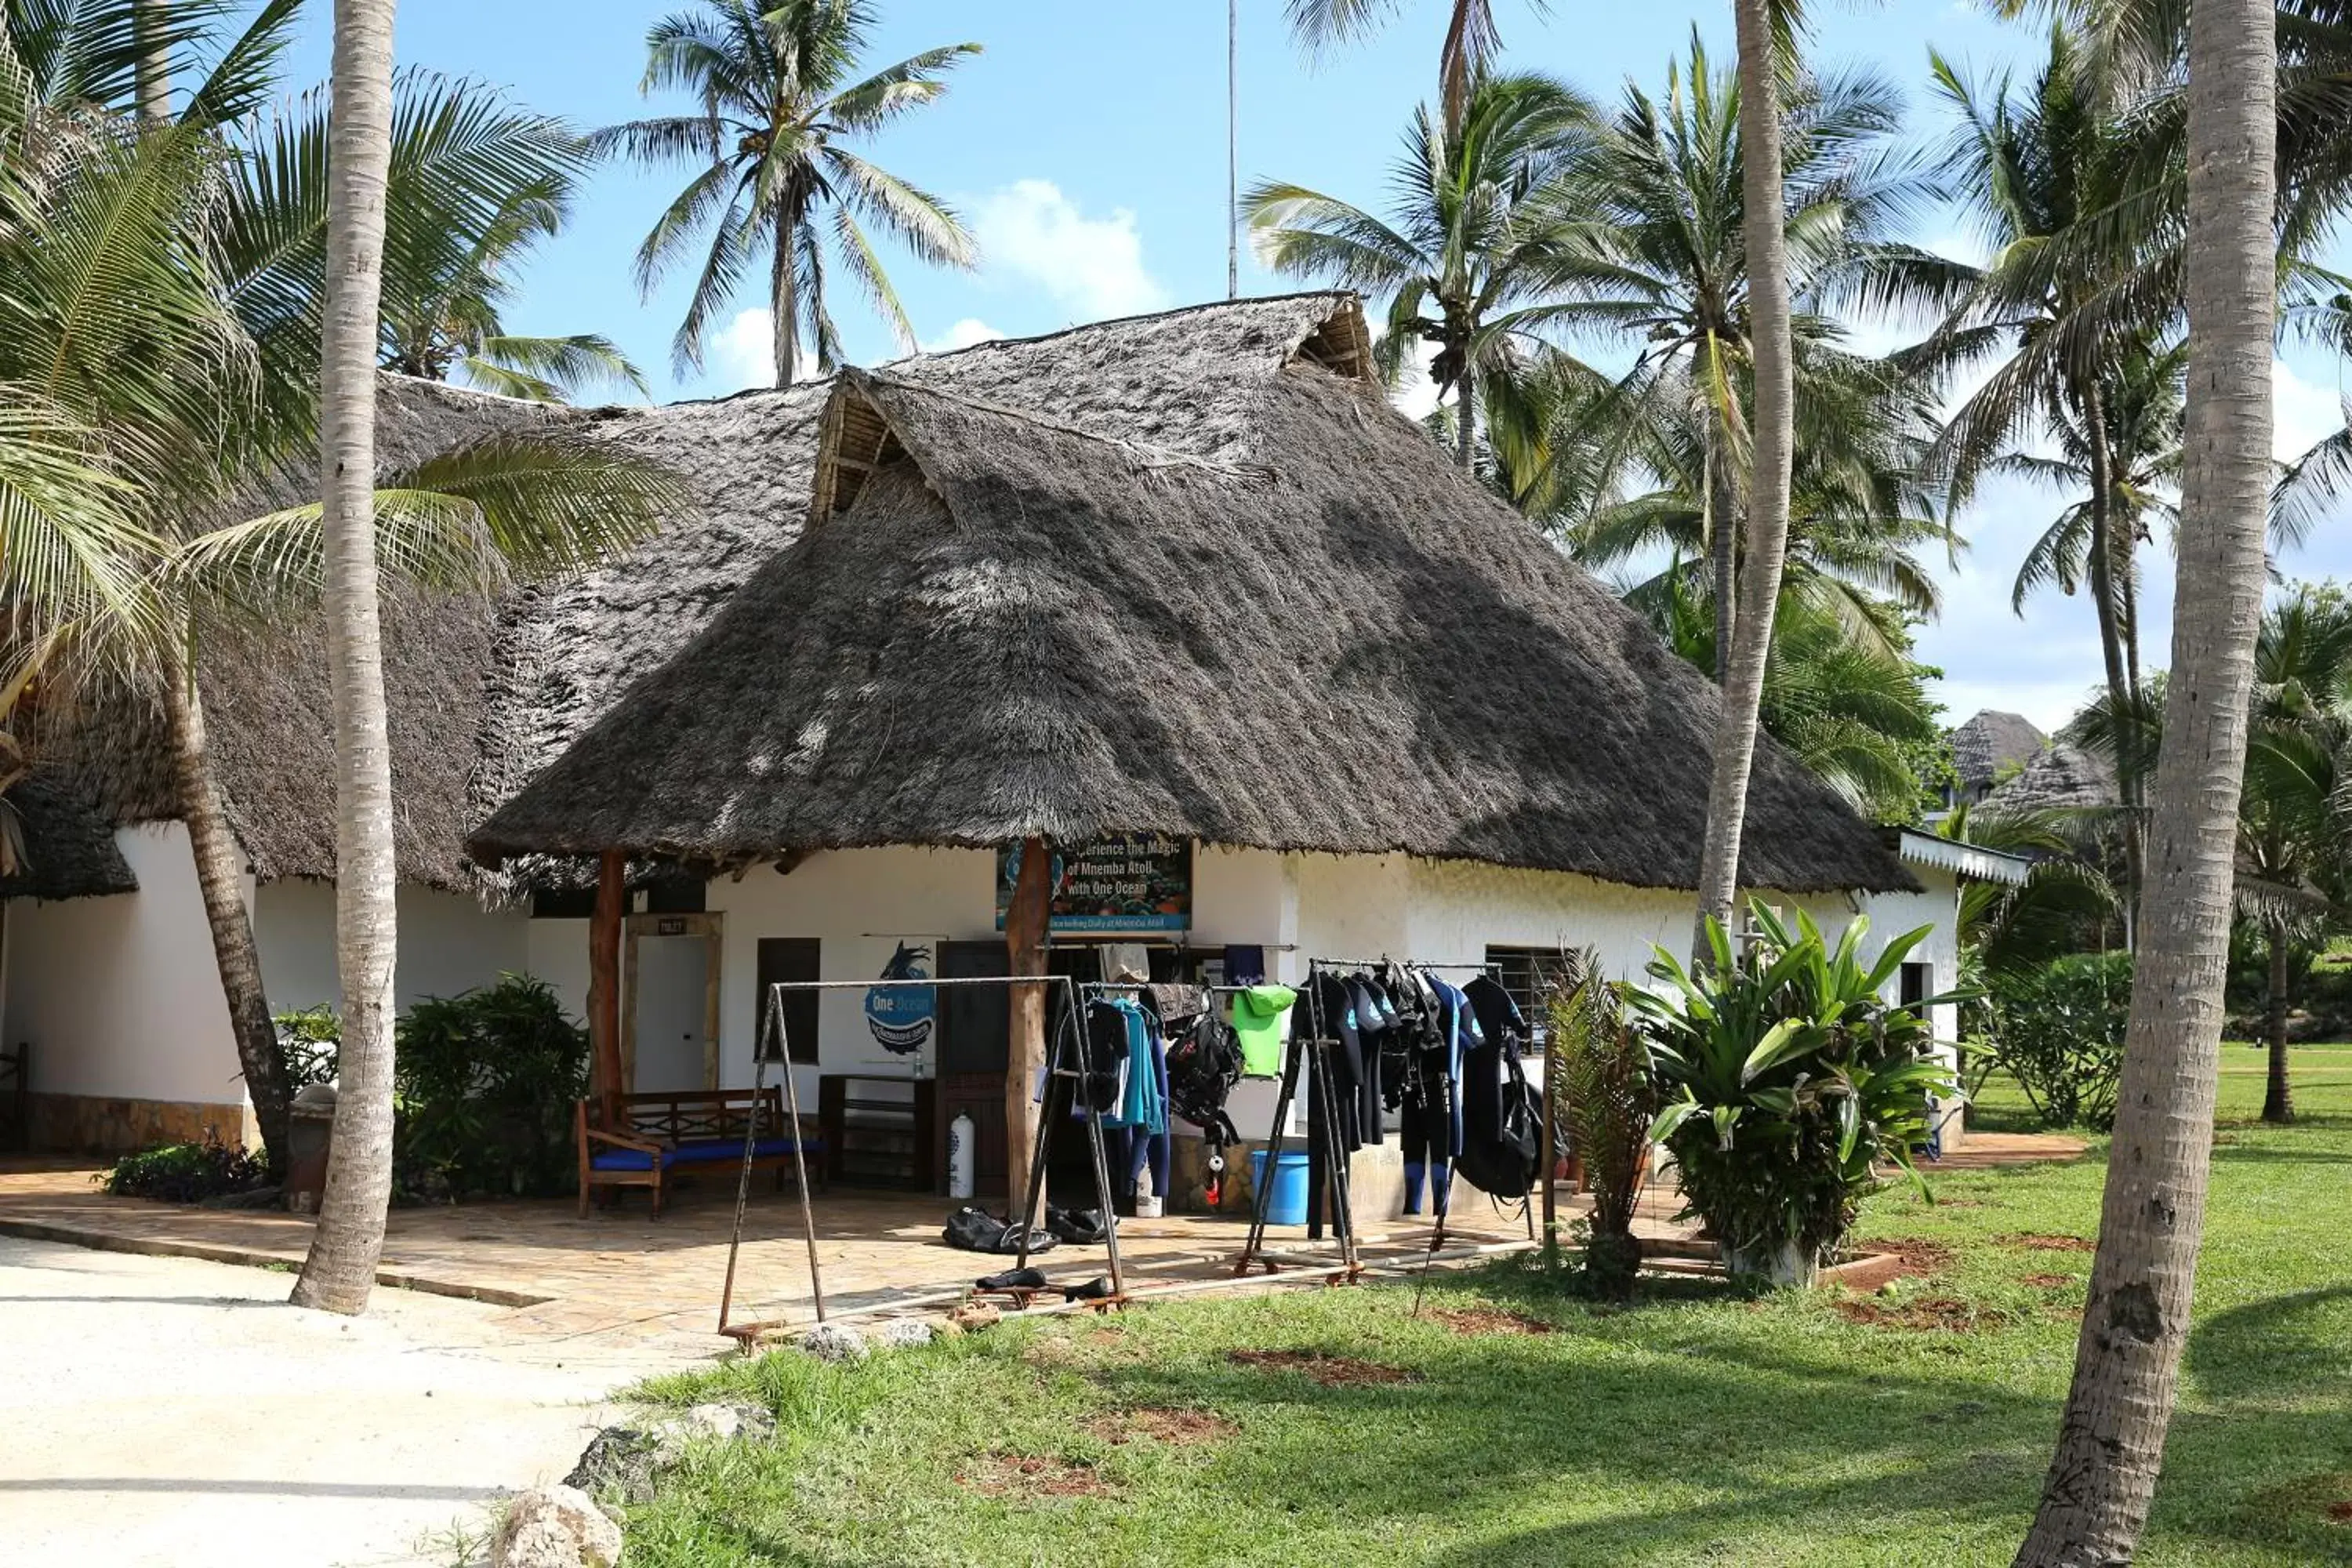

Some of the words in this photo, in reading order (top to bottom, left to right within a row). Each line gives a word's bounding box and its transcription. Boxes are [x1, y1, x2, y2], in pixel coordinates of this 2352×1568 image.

[1127, 840, 1145, 855] the
[1067, 862, 1079, 876] of
[1082, 862, 1125, 876] Mnemba
[1128, 860, 1152, 874] Atoll
[1068, 881, 1091, 895] with
[1092, 881, 1112, 895] One
[1116, 880, 1147, 895] Ocean
[873, 995, 893, 1011] One
